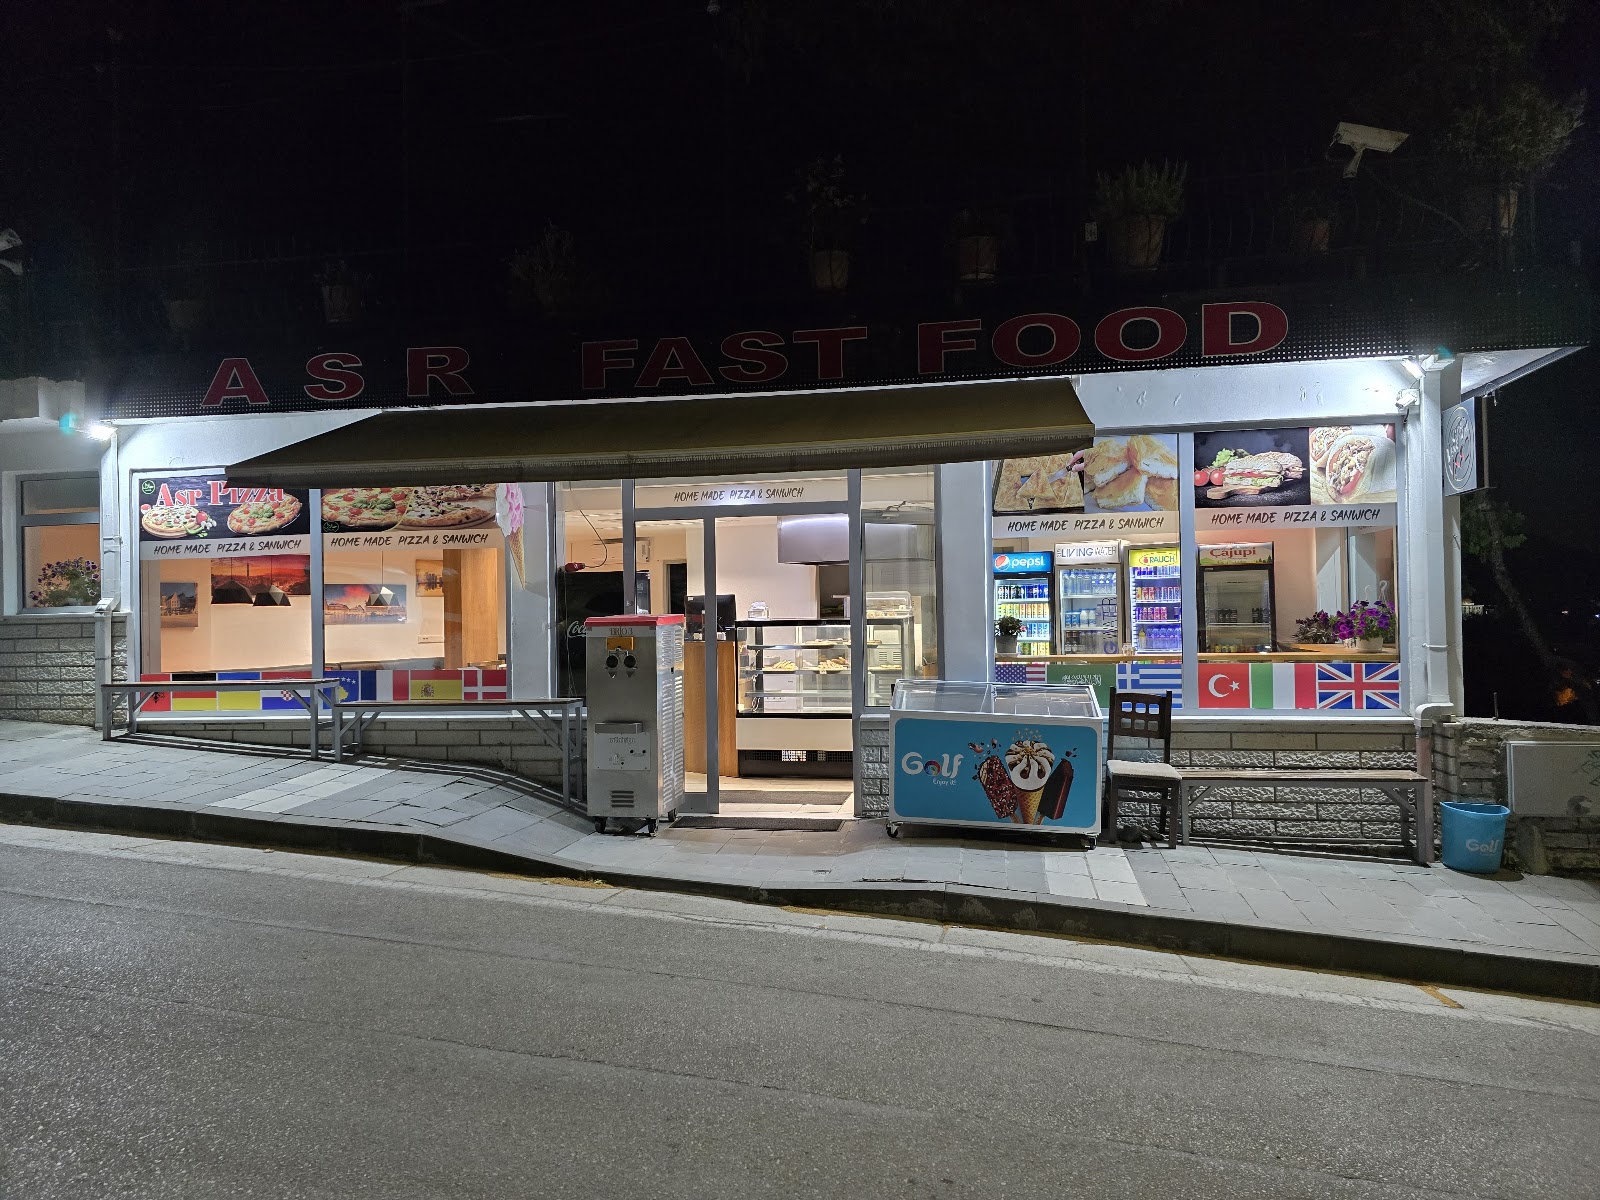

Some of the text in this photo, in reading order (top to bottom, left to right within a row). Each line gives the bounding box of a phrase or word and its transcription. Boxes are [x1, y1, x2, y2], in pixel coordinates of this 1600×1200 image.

[581, 325, 868, 390] FAST
[918, 301, 1289, 374] FOOD
[155, 482, 203, 507] Asr
[207, 480, 285, 506] Pizza
[674, 487, 804, 502] HOME MADE PIZZA & SANWICH
[1211, 508, 1380, 525] HOME MADE PIZZA & SANWICH
[1007, 517, 1164, 532] HOME MADE PIZZA & SANWICH
[153, 539, 302, 555] HOME MADE PIZZA & SANWICH
[330, 533, 489, 547] HOME MADE PIZZA & SANWICH
[1061, 547, 1094, 558] LIVING
[1149, 555, 1175, 564] RAUCH
[1011, 555, 1045, 569] pepsi
[901, 751, 964, 778] Golf
[932, 778, 948, 787] Enjoy
[1465, 839, 1500, 853] Golf
